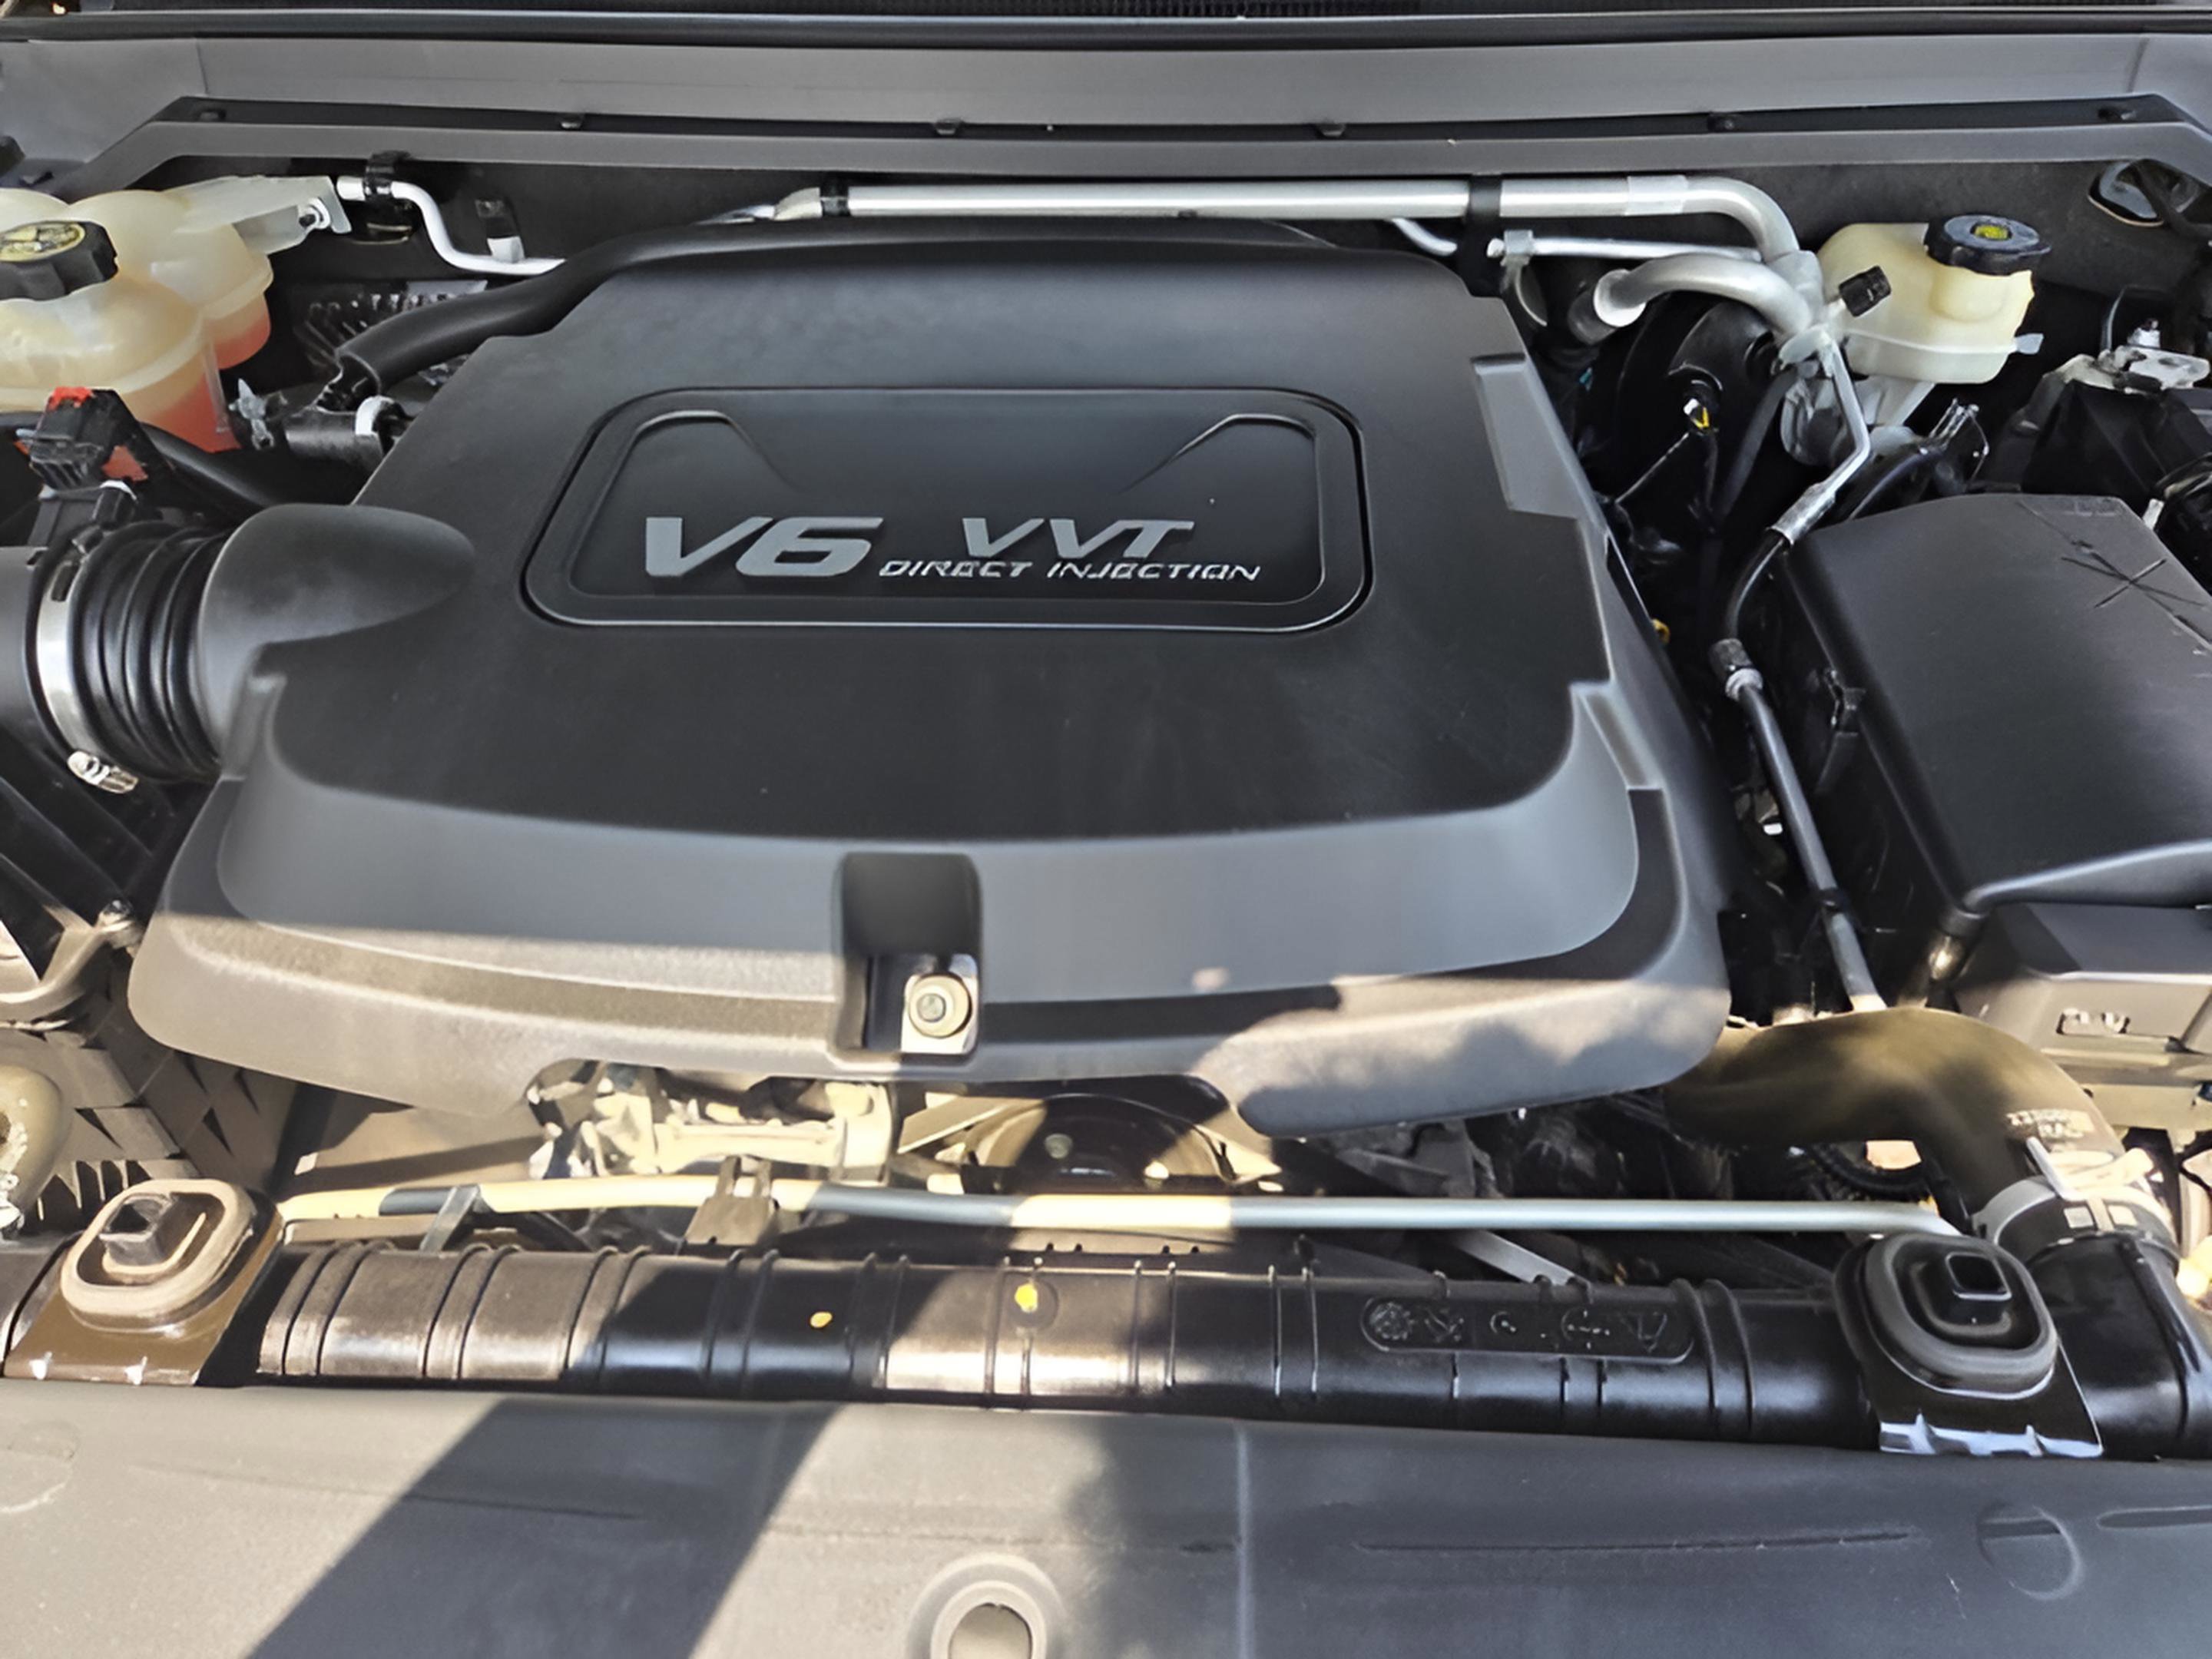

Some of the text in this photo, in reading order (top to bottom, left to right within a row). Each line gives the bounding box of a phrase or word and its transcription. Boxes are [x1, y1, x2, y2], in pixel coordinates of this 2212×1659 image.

[645, 516, 1195, 577] V6 VVT
[879, 560, 1261, 581] DIRECT INJECTION
